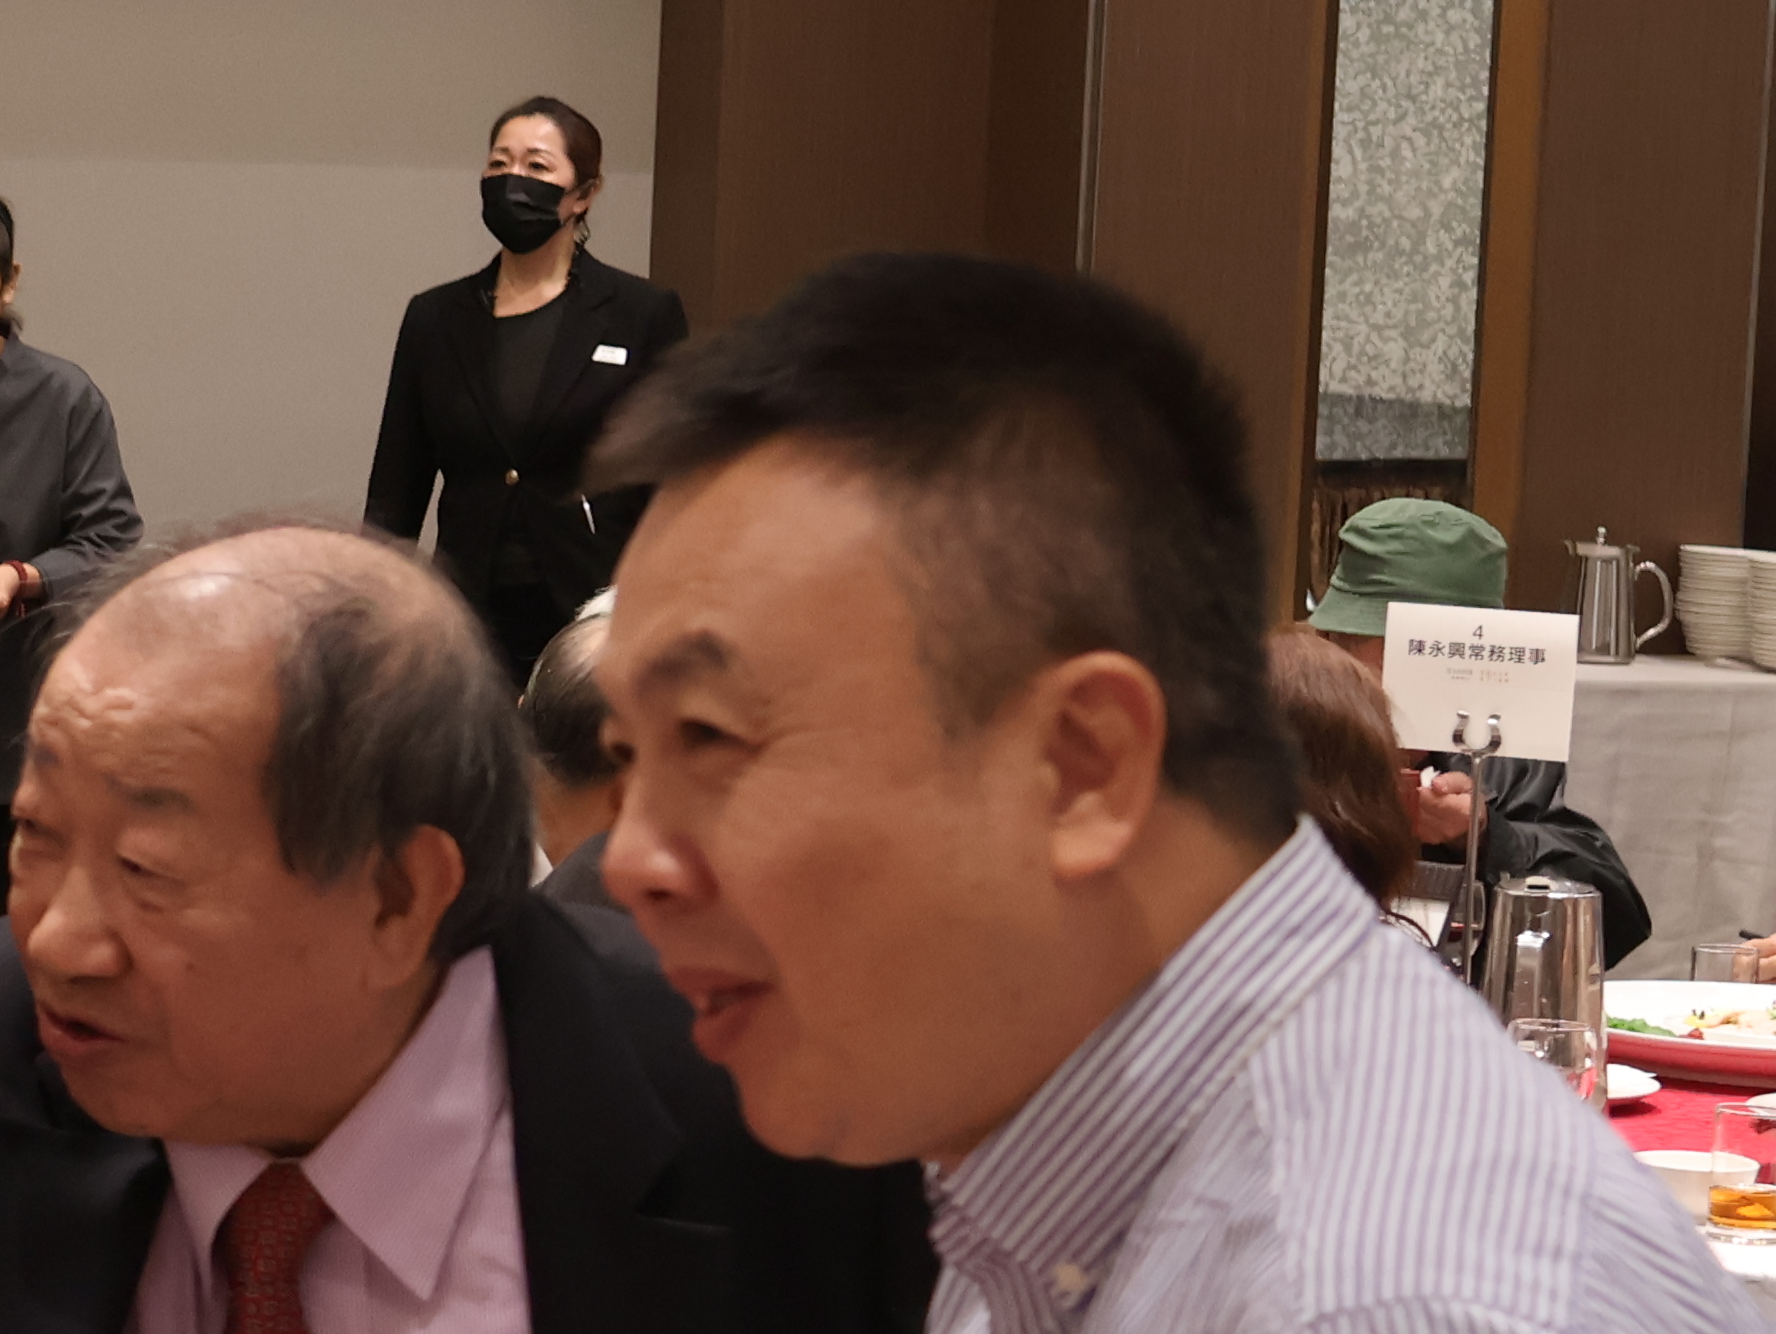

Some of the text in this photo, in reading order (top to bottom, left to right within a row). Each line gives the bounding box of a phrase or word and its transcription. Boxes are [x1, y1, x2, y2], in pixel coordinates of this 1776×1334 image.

[1472, 625, 1484, 640] 4
[1408, 639, 1546, 665] 陳永興常務理事
